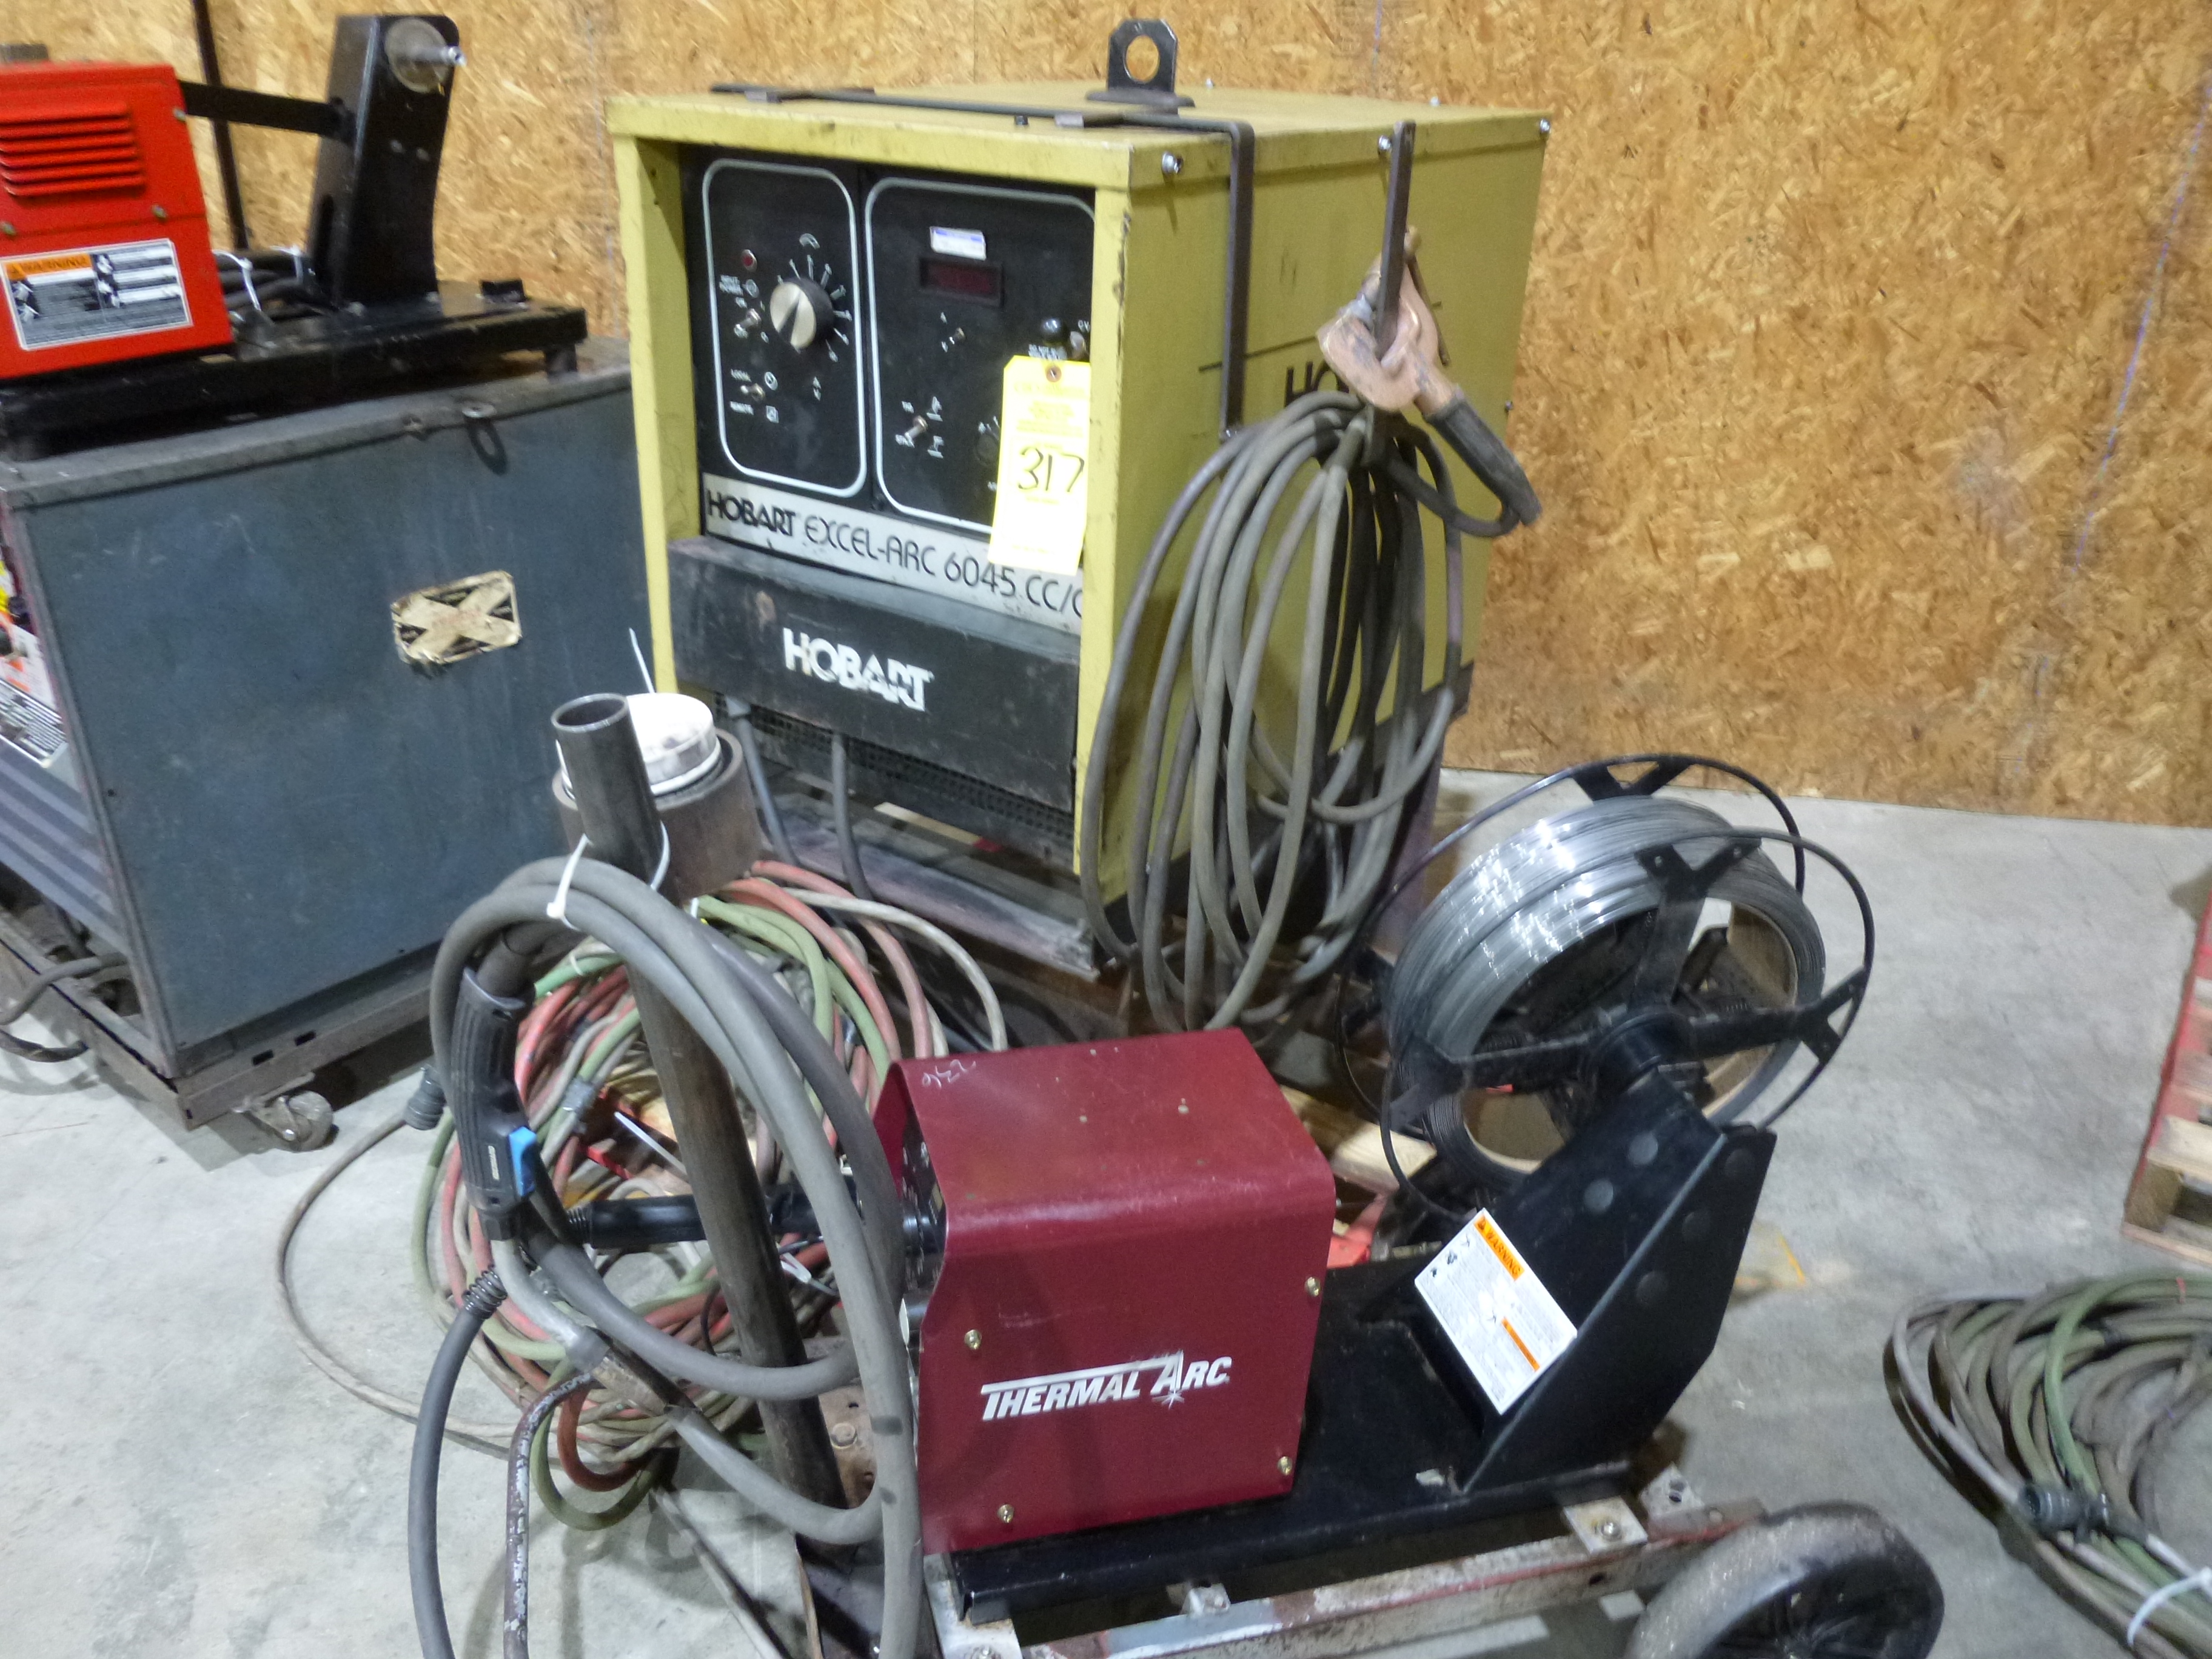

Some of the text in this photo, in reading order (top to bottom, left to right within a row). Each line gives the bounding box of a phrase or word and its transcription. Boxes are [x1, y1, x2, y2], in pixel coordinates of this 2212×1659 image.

[1018, 446, 1085, 492] 317
[707, 490, 796, 537] HOBART
[804, 515, 936, 576] EXCEL-ARC
[943, 552, 1016, 597] 6045
[783, 627, 934, 712] HOBART
[1487, 1228, 1521, 1275] WARNING
[980, 1350, 1232, 1421] THERMAL ARC
